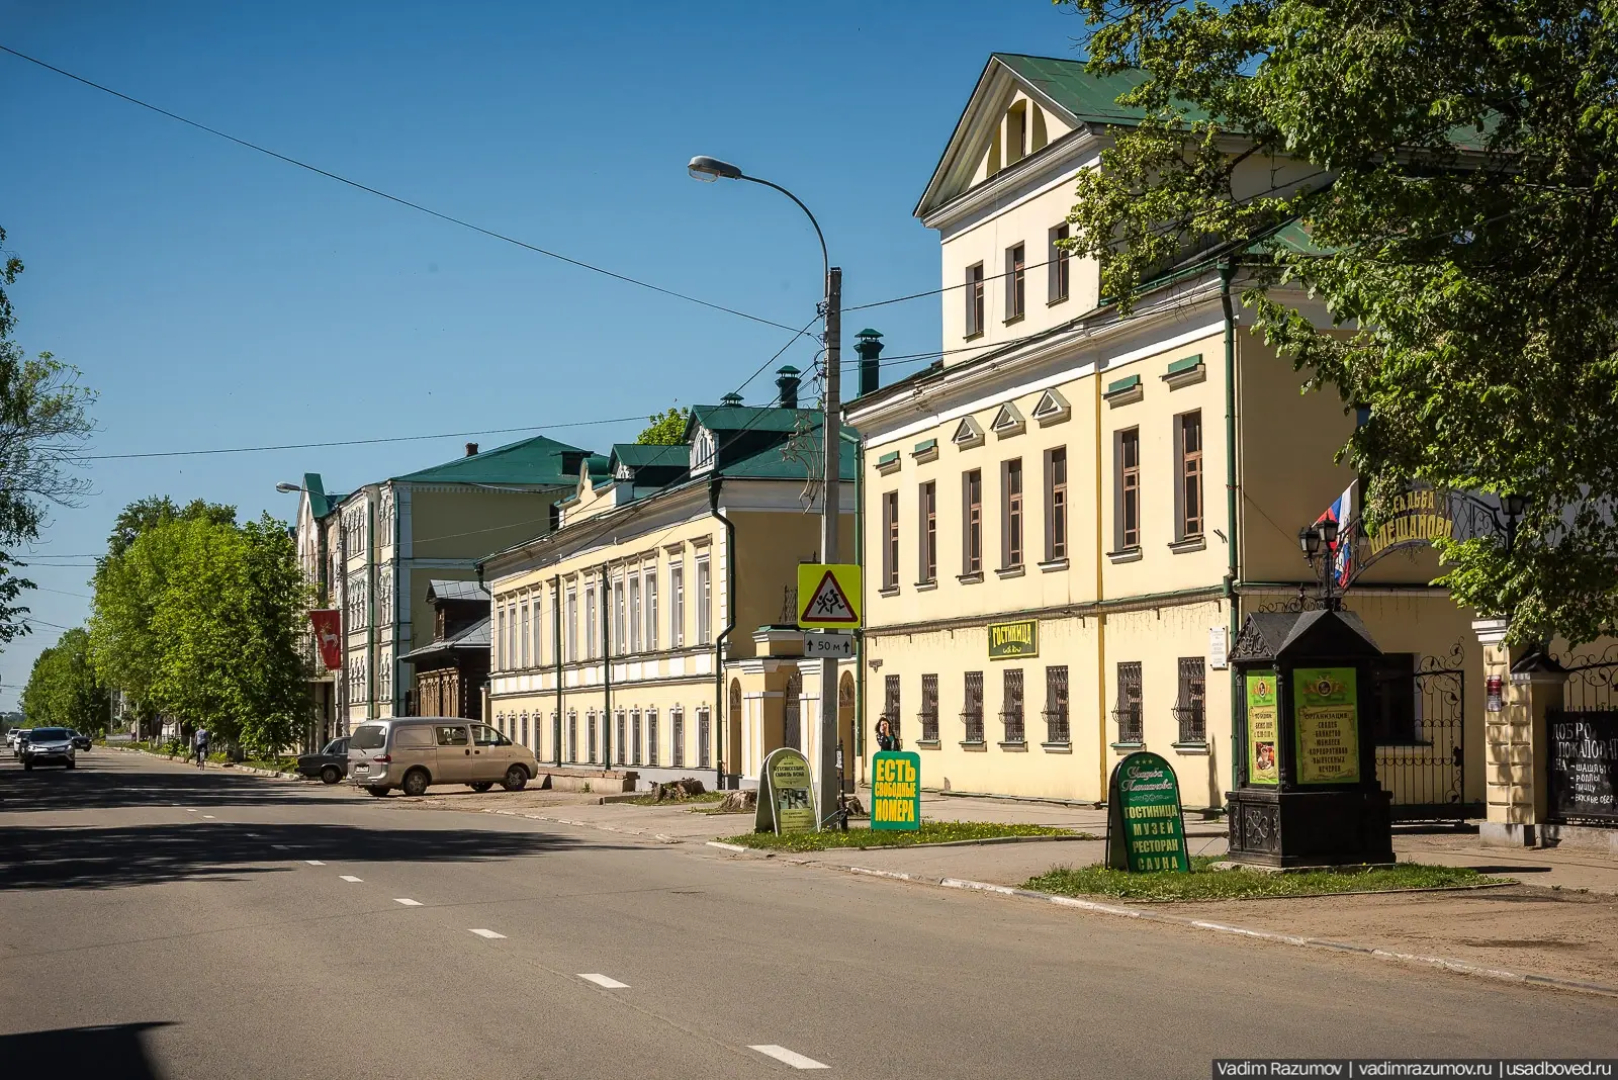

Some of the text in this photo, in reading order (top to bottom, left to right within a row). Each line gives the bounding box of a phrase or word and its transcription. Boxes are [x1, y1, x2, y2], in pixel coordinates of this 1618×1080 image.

[1391, 490, 1435, 515] САДЬБА
[993, 623, 1032, 649] ГОСТИНИЦА
[818, 641, 831, 651] 50
[1552, 722, 1592, 741] ДОБРО
[876, 759, 916, 782] ЕСТЬ
[1555, 758, 1568, 771] НА
[875, 782, 917, 800] СВОБОДНЫЕ
[875, 799, 915, 822] НОМЕРА
[1124, 805, 1178, 819] ГОСТИНИЦА
[1133, 820, 1174, 836] МУЗЕЙ
[1132, 838, 1179, 854] РЕСТОРАН
[1138, 856, 1178, 871] САУНА
